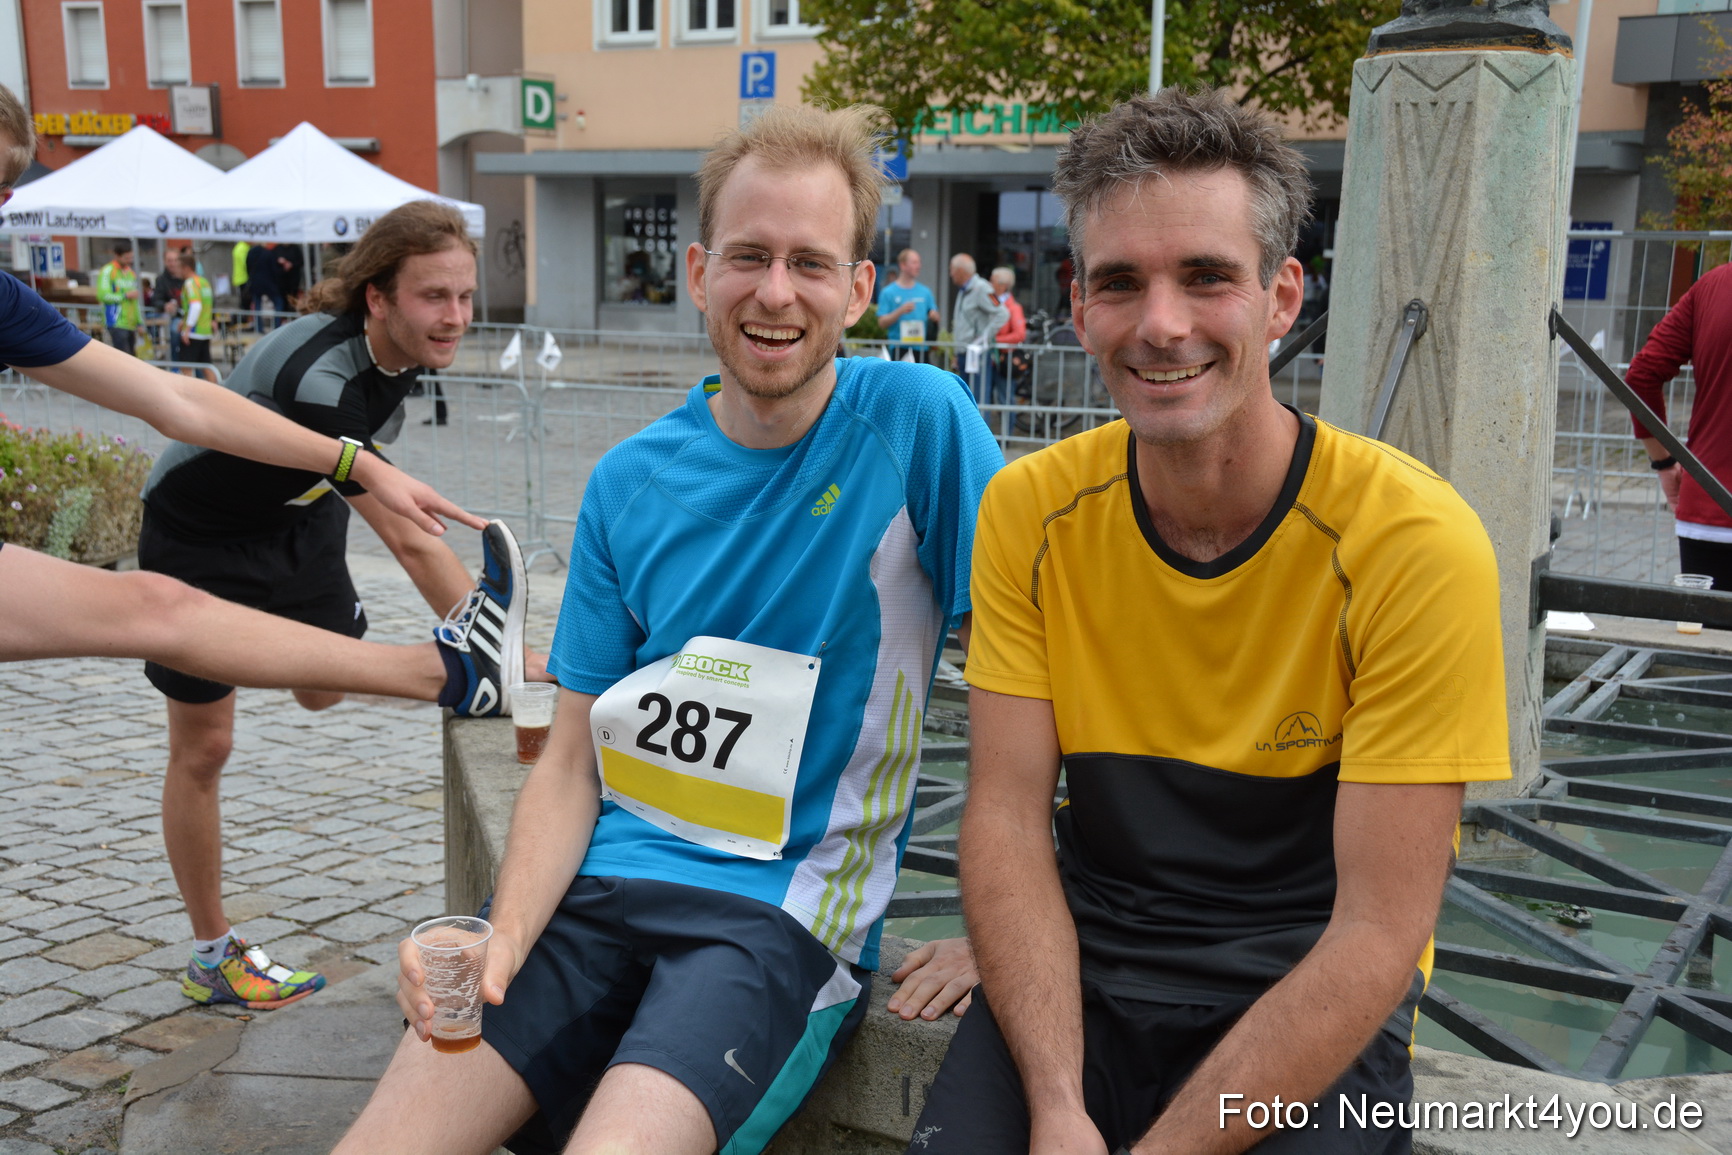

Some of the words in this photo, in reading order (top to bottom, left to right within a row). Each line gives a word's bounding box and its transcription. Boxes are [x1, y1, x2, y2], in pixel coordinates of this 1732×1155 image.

[746, 55, 769, 95] P
[525, 85, 552, 123] D
[34, 113, 66, 135] DER
[68, 110, 133, 135] BÄCKER
[9, 211, 43, 227] BMW
[46, 210, 107, 230] Laufsport
[175, 216, 211, 233] BMW
[213, 217, 277, 237] Laufsport
[676, 669, 697, 678] inspired
[698, 672, 706, 680] by
[706, 675, 723, 683] smart
[724, 679, 750, 688] concepts
[678, 653, 752, 682] BOCK
[603, 730, 610, 740] D
[636, 692, 753, 770] 287
[1256, 742, 1273, 751] LA
